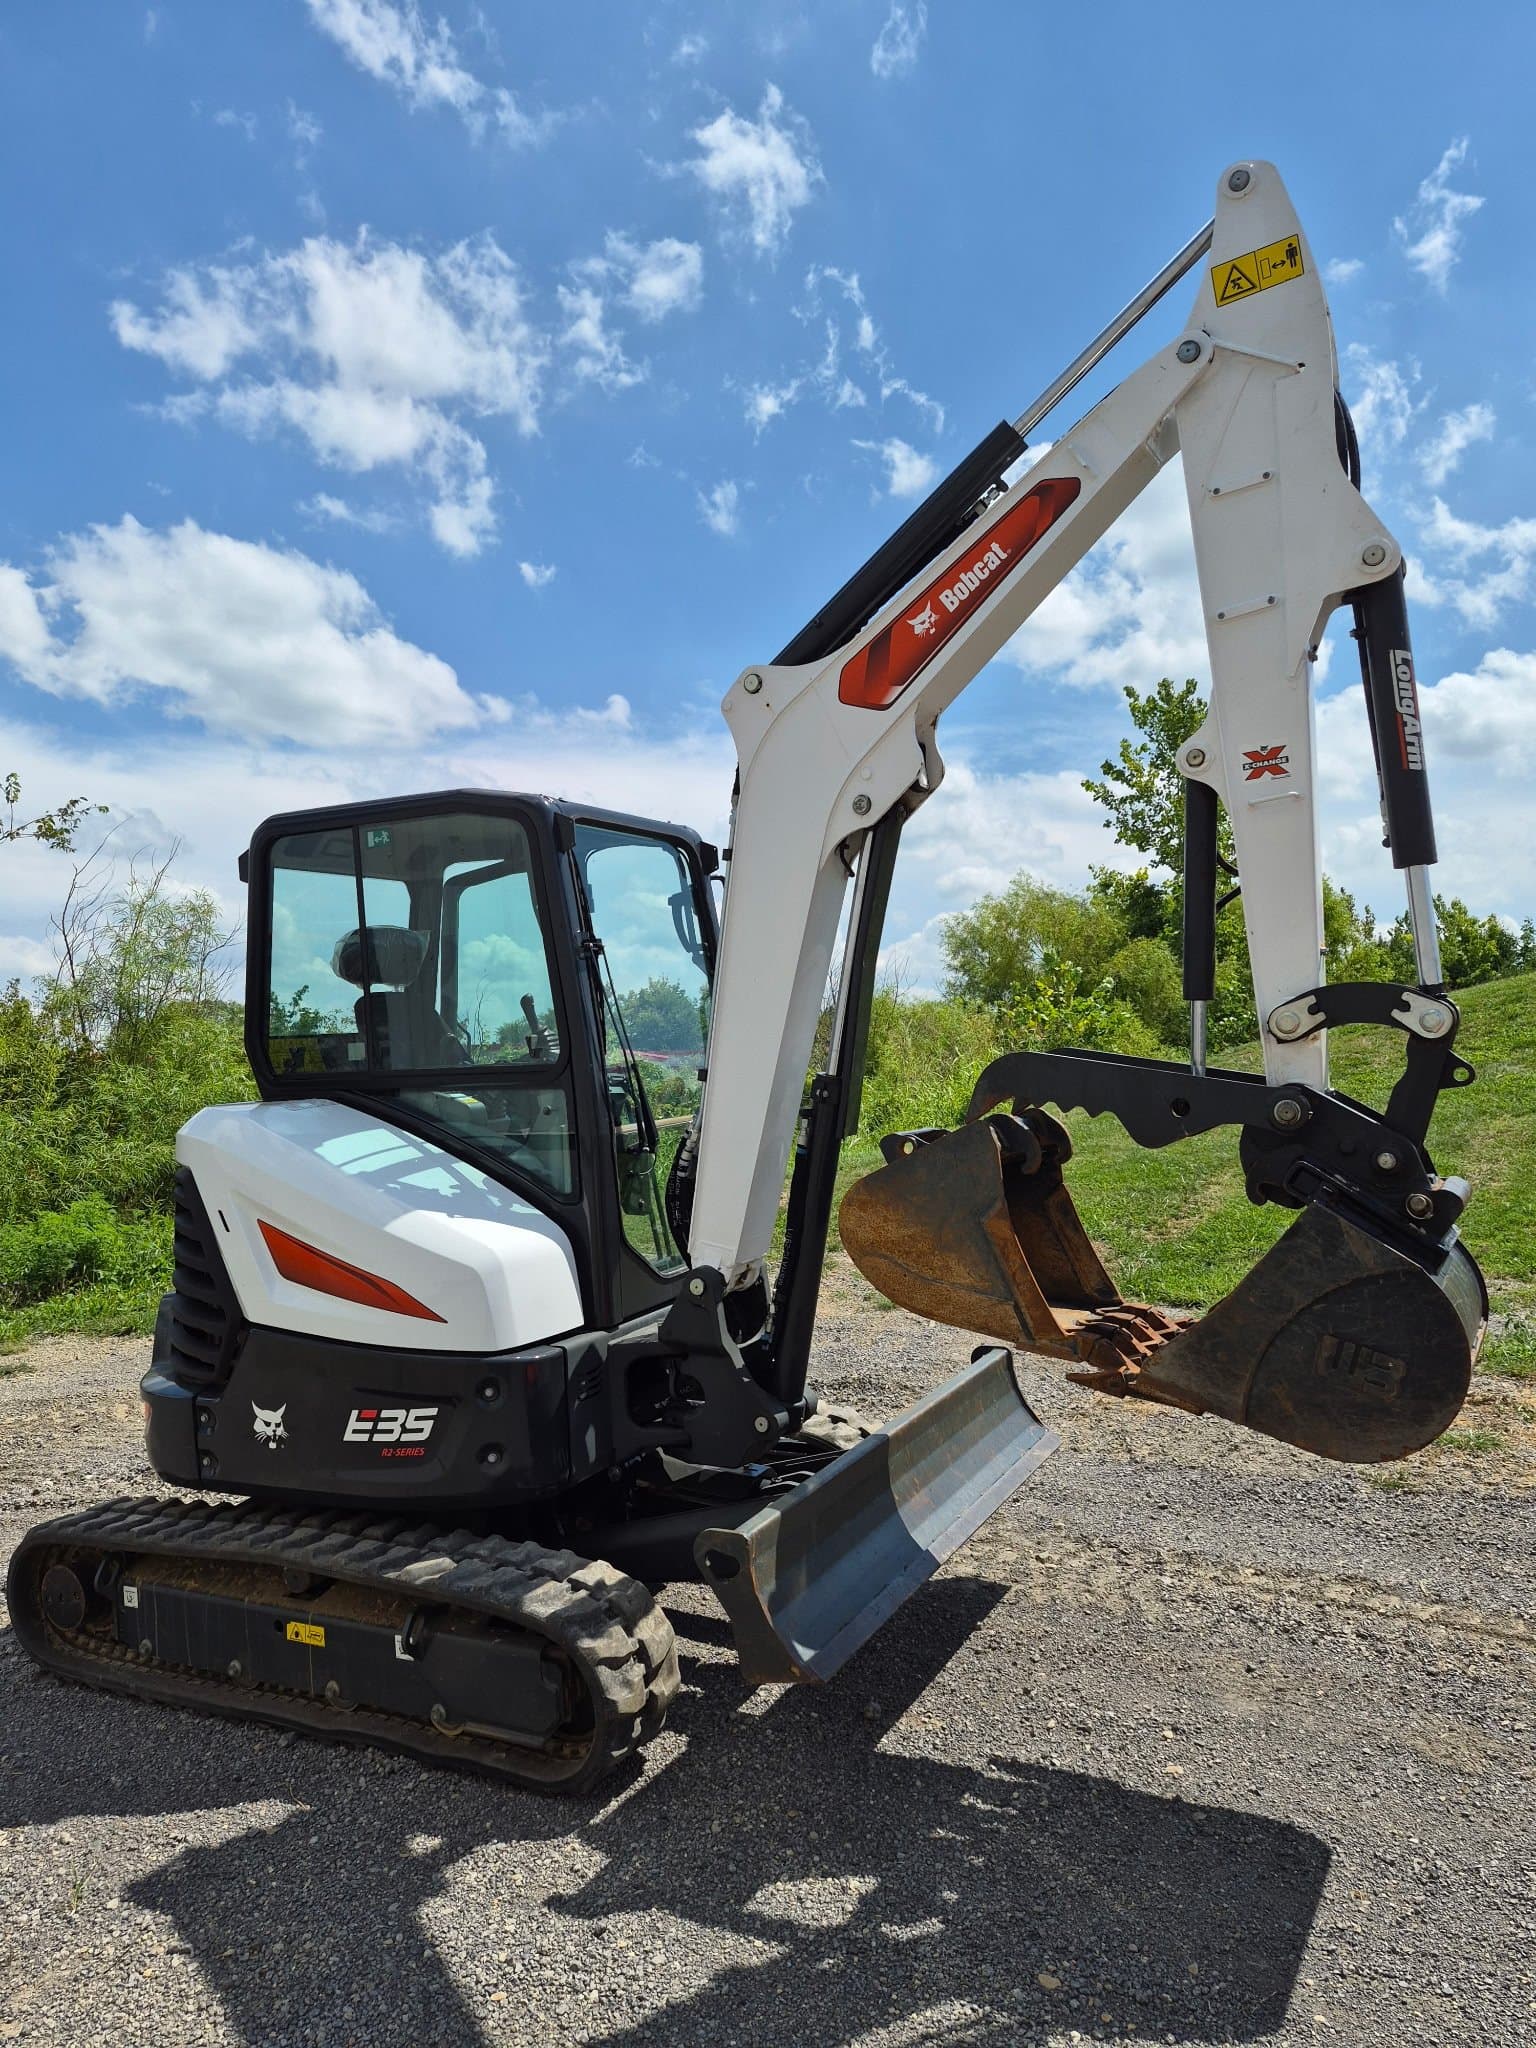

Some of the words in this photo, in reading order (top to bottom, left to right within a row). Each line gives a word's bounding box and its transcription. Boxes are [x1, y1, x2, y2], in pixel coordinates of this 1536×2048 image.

[938, 542, 1008, 612] Bobcat
[1391, 649, 1423, 771] LongArm
[343, 1407, 438, 1442] E35
[381, 1447, 425, 1457] R2-SERIES
